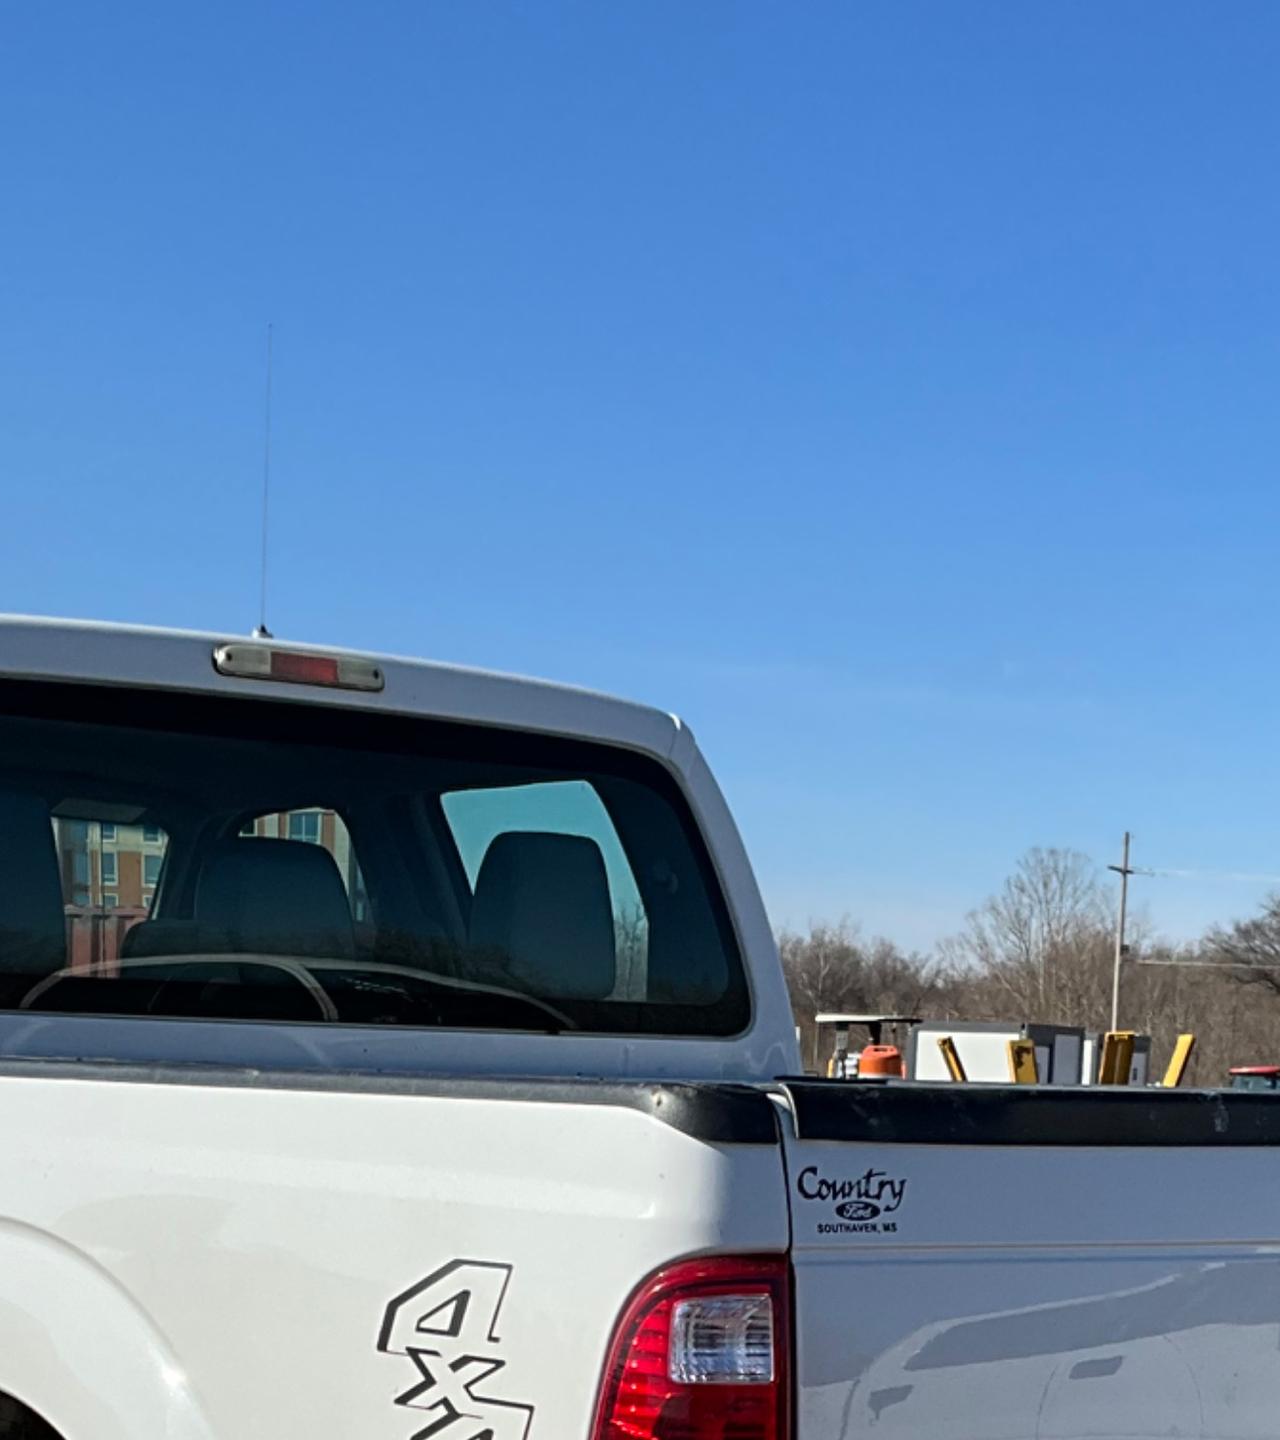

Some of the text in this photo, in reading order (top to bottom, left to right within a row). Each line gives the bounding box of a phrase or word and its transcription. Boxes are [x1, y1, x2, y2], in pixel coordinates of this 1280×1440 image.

[797, 1165, 907, 1212] Country
[842, 1203, 873, 1218] Ford
[817, 1222, 897, 1234] SOUTHAVEN, MS
